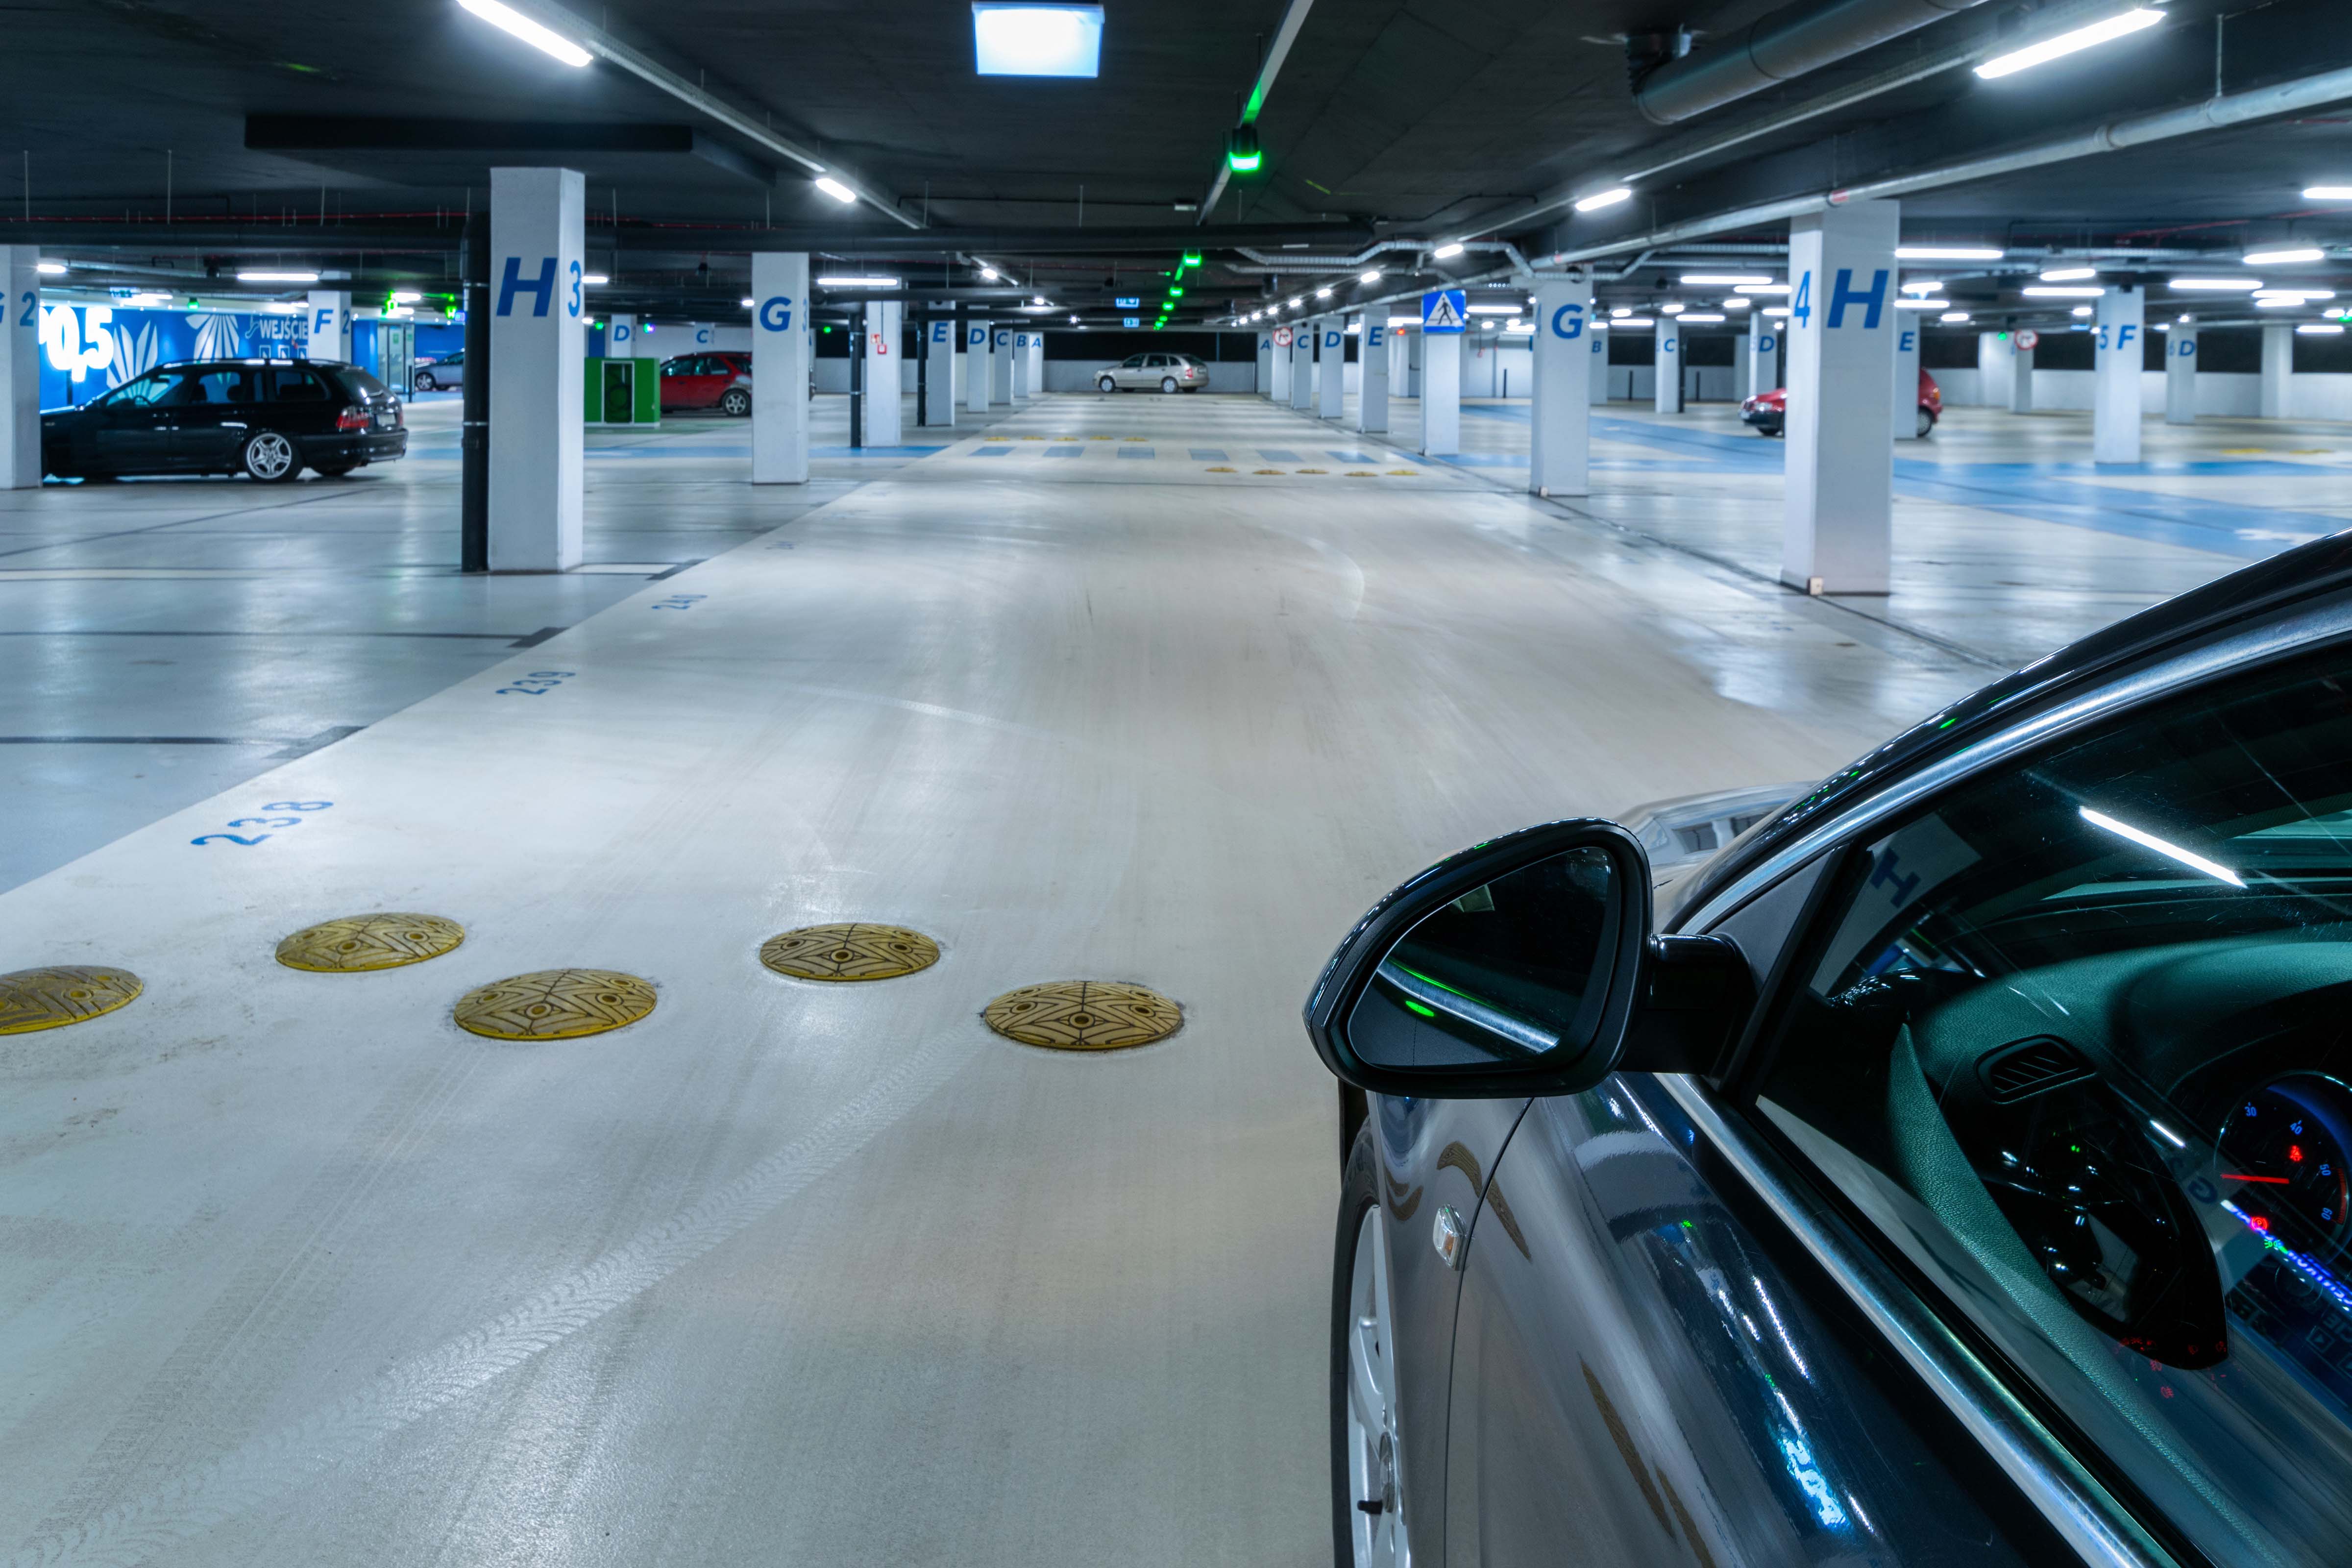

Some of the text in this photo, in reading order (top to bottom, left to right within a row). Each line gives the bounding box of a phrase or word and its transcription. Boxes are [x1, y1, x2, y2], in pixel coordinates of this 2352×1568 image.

[496, 257, 558, 317] H
[568, 260, 581, 317] 3
[1794, 270, 1811, 328] 4
[1827, 269, 1889, 328] H
[20, 291, 36, 327] 2
[760, 296, 792, 332] G
[260, 316, 308, 340] WEJŚCIE
[314, 309, 334, 334] F
[342, 309, 350, 334] 2
[1552, 304, 1583, 339] G
[613, 325, 630, 342] D
[696, 330, 709, 343] C
[932, 322, 948, 343] E
[970, 328, 985, 344] D
[997, 332, 1009, 346] C
[1017, 335, 1027, 347] B
[1297, 335, 1309, 348] C
[1325, 331, 1341, 347] D
[1369, 326, 1384, 346] E
[1899, 332, 1914, 351] E
[2099, 325, 2109, 350] 5
[2117, 325, 2136, 350] F
[1031, 338, 1041, 348] A
[1260, 339, 1271, 350] A
[1592, 341, 1602, 353] B
[1664, 339, 1676, 352] C
[1759, 336, 1775, 352] D
[2179, 340, 2196, 356] D
[495, 672, 575, 695] 239
[191, 801, 334, 846] 238
[2244, 1106, 2257, 1117] 30
[2290, 1123, 2303, 1135] 40
[2319, 1164, 2331, 1176] 50
[2321, 1207, 2333, 1221] 60
